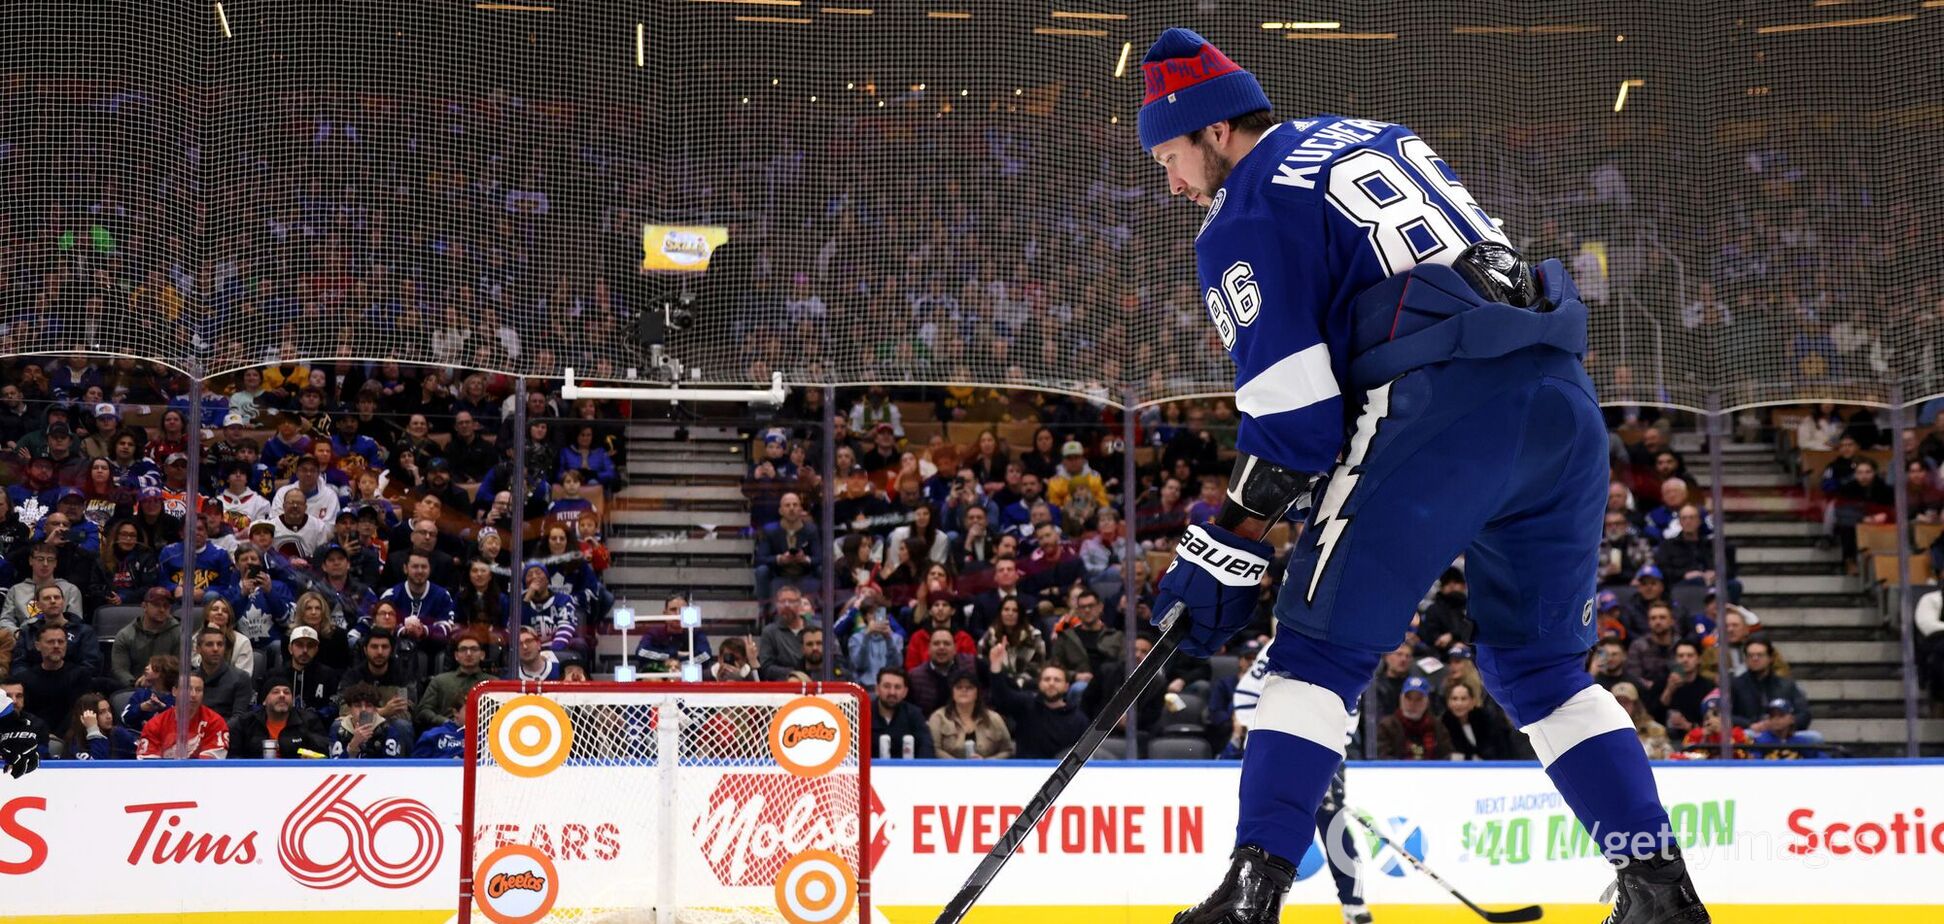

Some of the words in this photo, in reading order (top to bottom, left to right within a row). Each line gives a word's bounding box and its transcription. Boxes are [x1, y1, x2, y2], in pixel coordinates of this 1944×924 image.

[1271, 119, 1399, 190] KUCHER
[1324, 134, 1514, 278] 86
[1206, 261, 1262, 352] 86
[781, 721, 838, 749] Cheetos
[124, 801, 259, 866] Tims
[277, 774, 444, 890] 60
[1163, 805, 1204, 854] IN
[1475, 796, 1506, 815] NEXT
[488, 870, 546, 900] Cheetos
